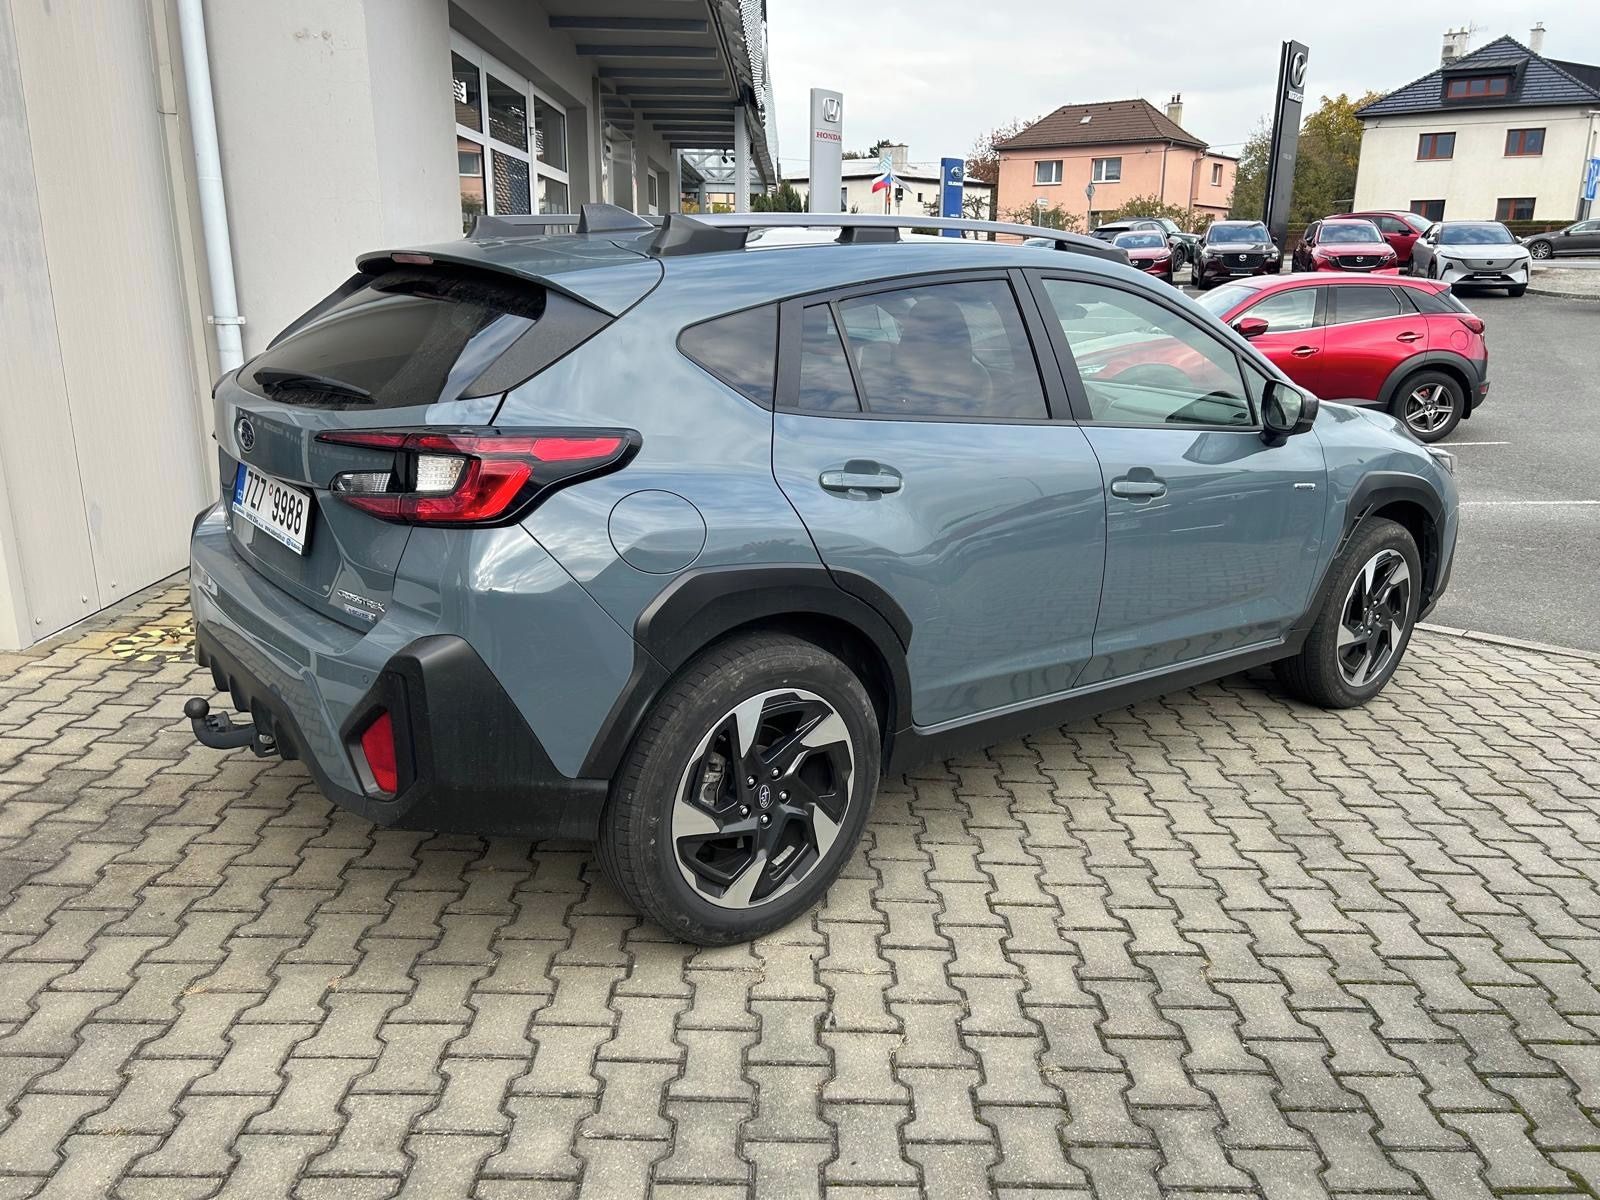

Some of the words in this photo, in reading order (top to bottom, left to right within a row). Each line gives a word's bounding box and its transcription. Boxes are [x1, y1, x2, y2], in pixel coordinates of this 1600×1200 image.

[816, 132, 841, 141] HONDA
[244, 471, 266, 511] 7Z7
[272, 487, 303, 535] 9988
